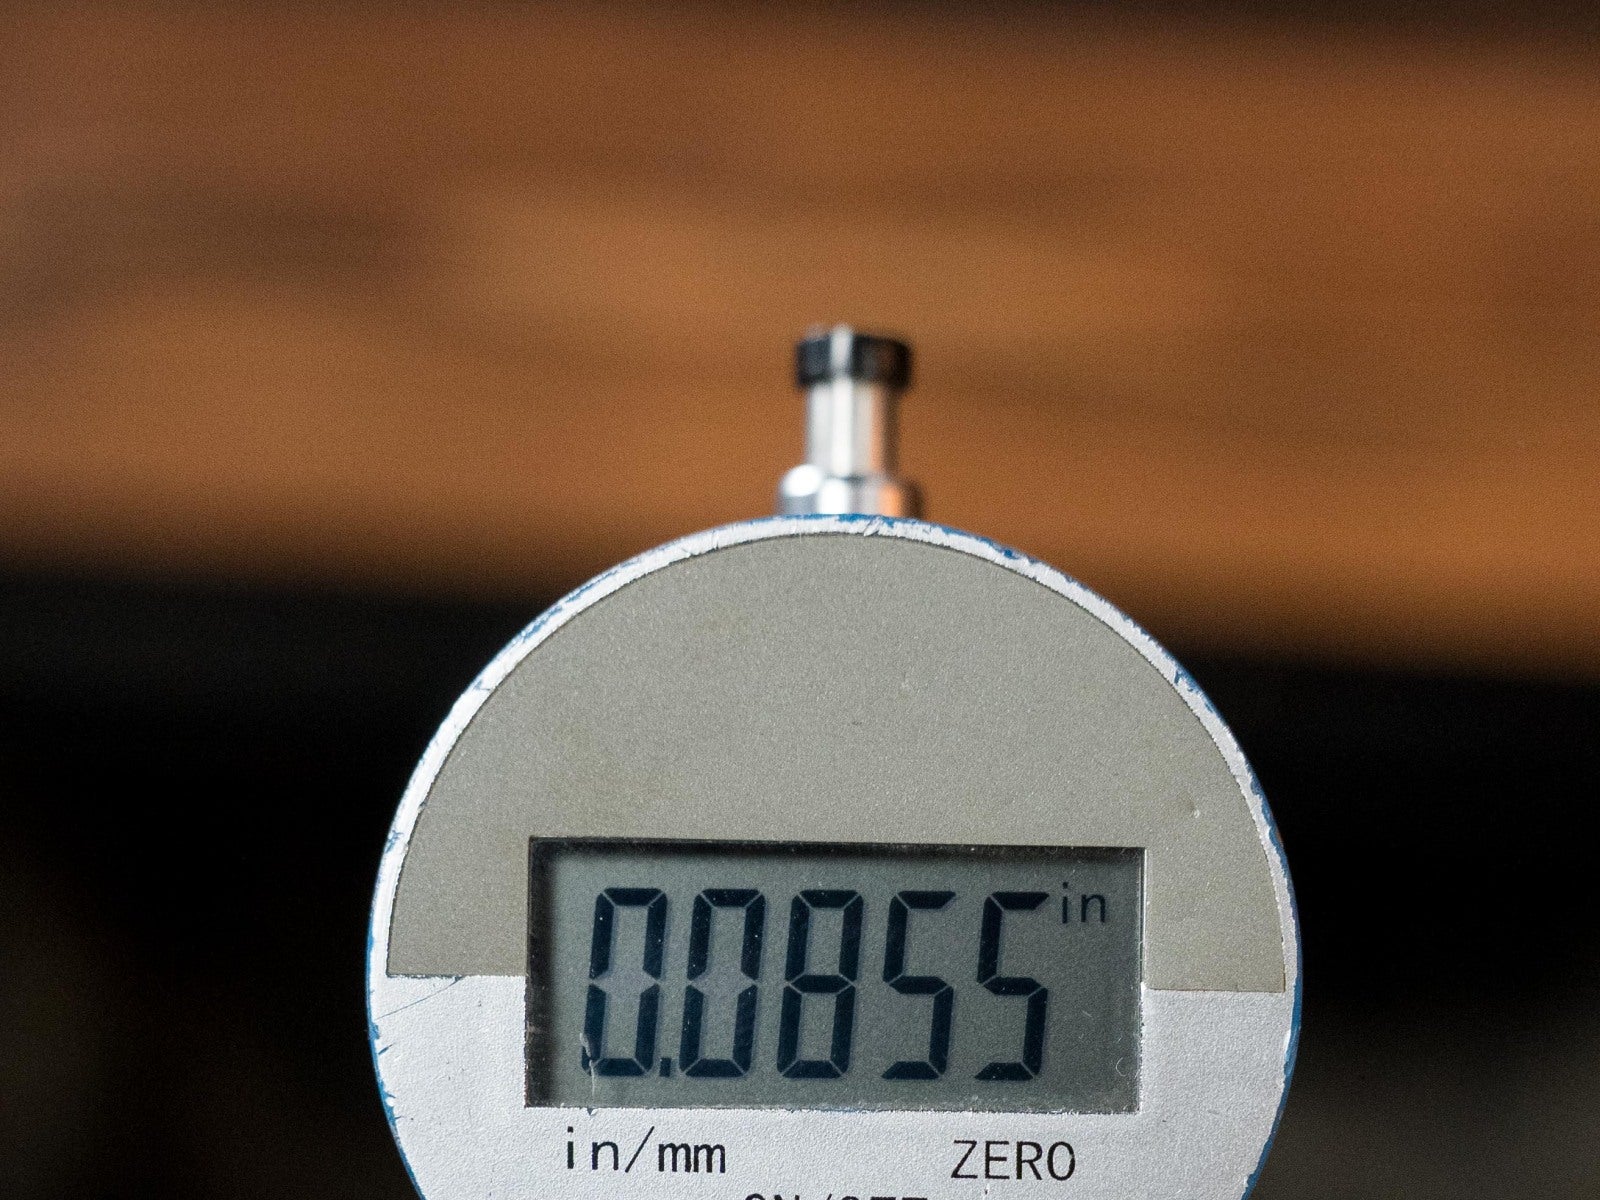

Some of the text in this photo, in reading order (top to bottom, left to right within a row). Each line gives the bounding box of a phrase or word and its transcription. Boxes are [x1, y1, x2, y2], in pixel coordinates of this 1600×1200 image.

[580, 882, 1108, 1081] 0.0855 in
[566, 1127, 727, 1174] in/mm
[951, 1140, 1077, 1182] ZERO
